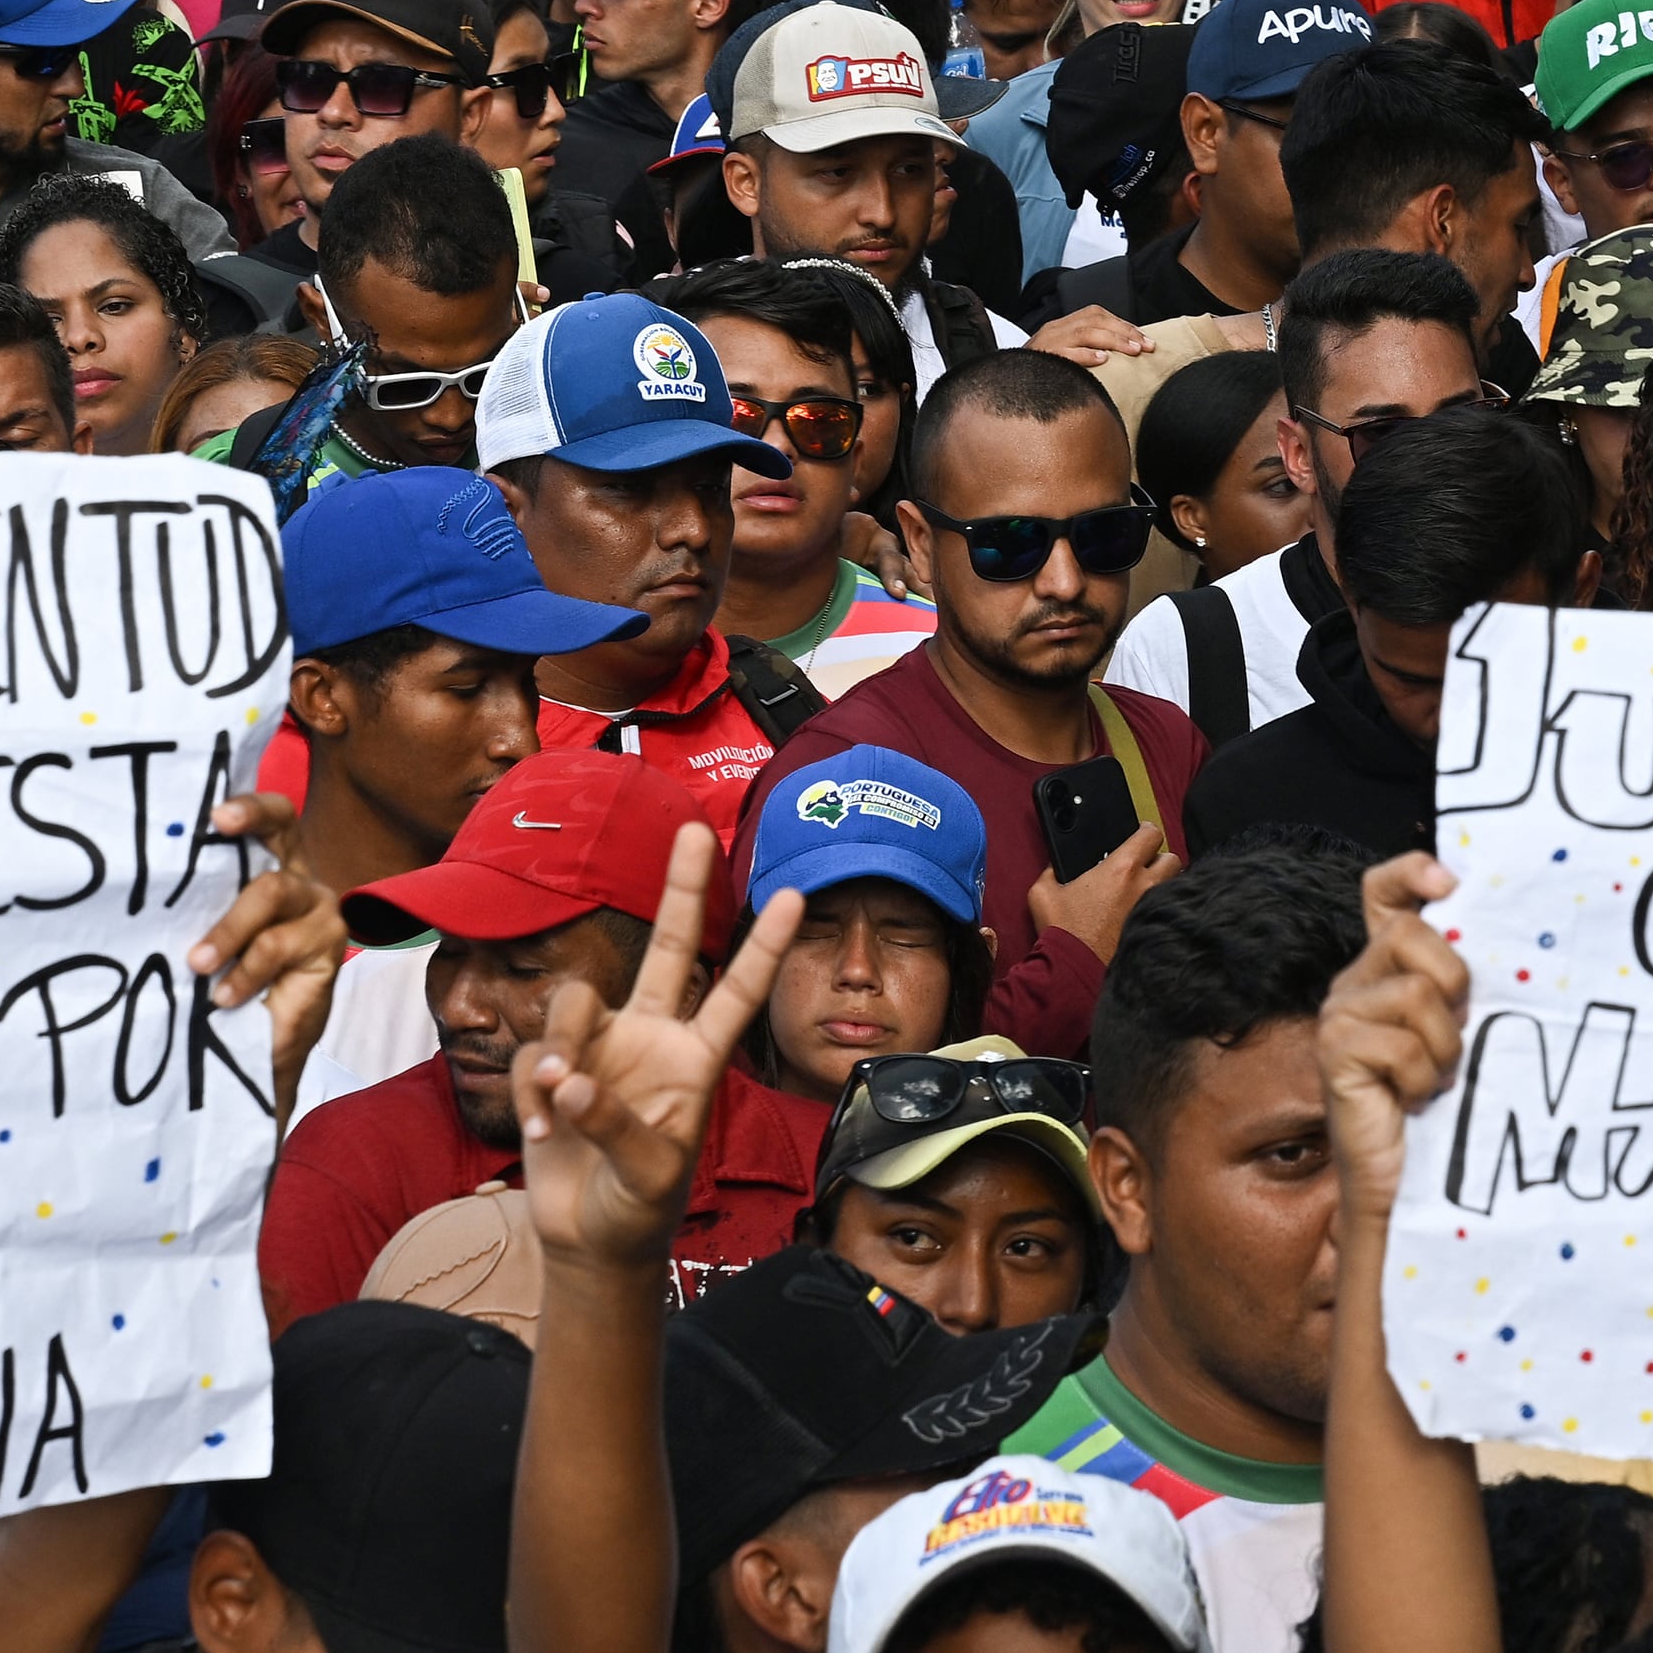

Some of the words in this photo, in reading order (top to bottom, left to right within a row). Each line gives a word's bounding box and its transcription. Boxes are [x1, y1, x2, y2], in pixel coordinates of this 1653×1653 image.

[847, 58, 921, 88] PSUV
[644, 383, 703, 398] YARACUY
[840, 782, 939, 819] PORTUGUESA
